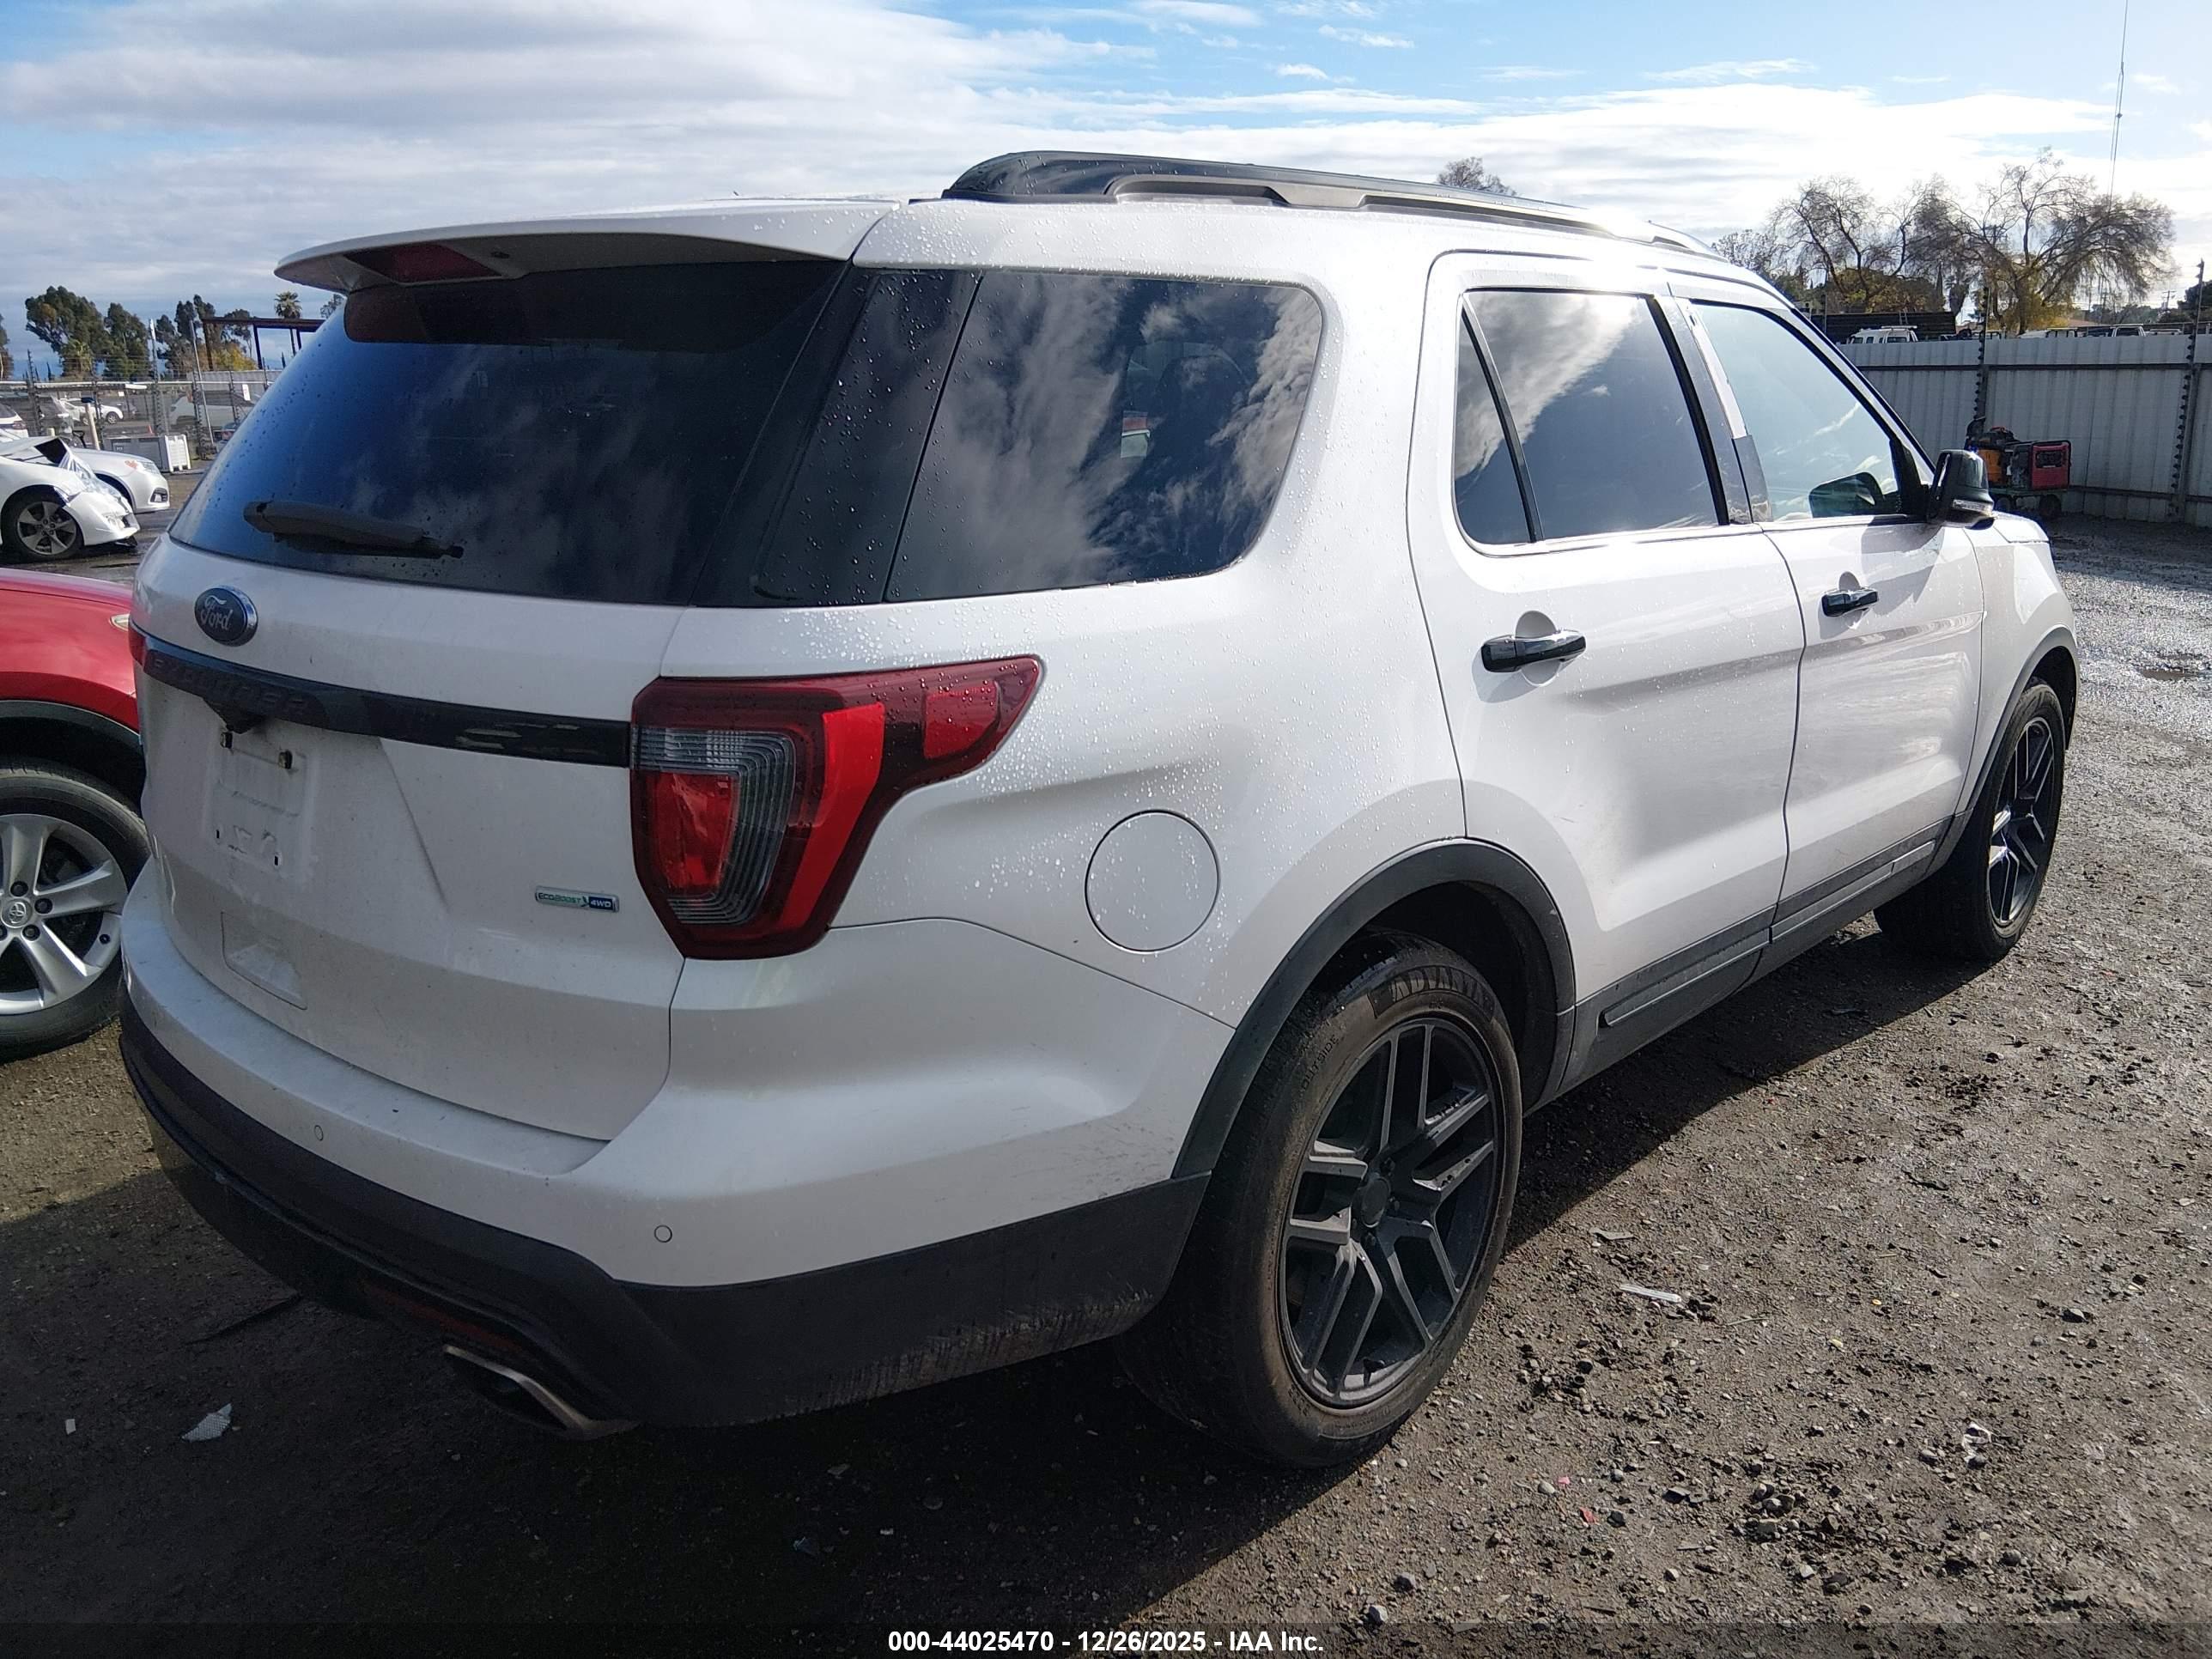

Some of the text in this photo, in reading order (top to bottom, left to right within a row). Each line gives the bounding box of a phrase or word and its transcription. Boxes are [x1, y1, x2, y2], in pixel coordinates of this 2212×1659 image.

[199, 594, 234, 631] Ford
[590, 899, 612, 908] 4WD
[1301, 1034, 1340, 1091] OUTSIDE
